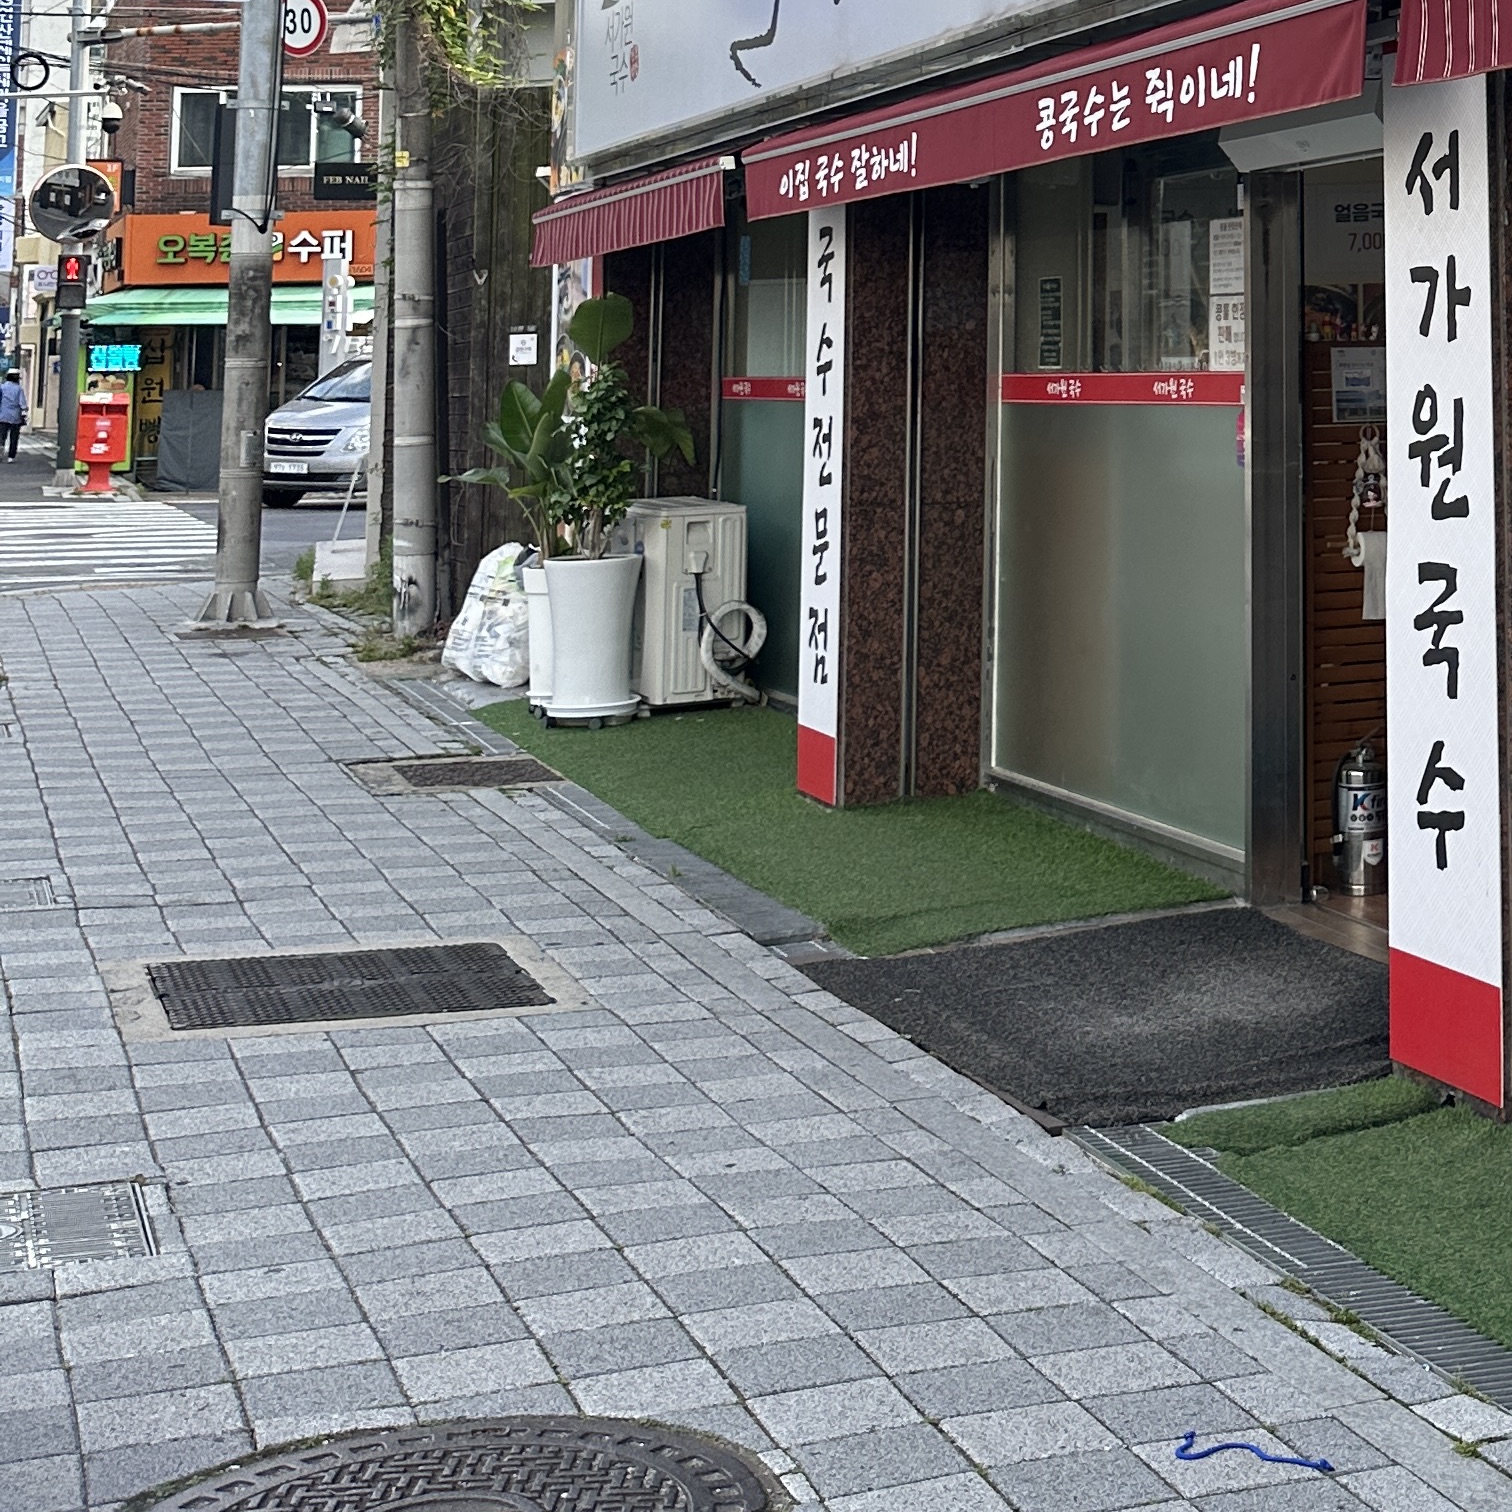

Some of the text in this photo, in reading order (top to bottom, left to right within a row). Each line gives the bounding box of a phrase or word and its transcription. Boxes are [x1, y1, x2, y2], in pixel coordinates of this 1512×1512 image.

[286, 8, 311, 34] 30
[1036, 80, 1131, 150] 콩국수는
[779, 132, 917, 201] 이집 국수 잘하네!
